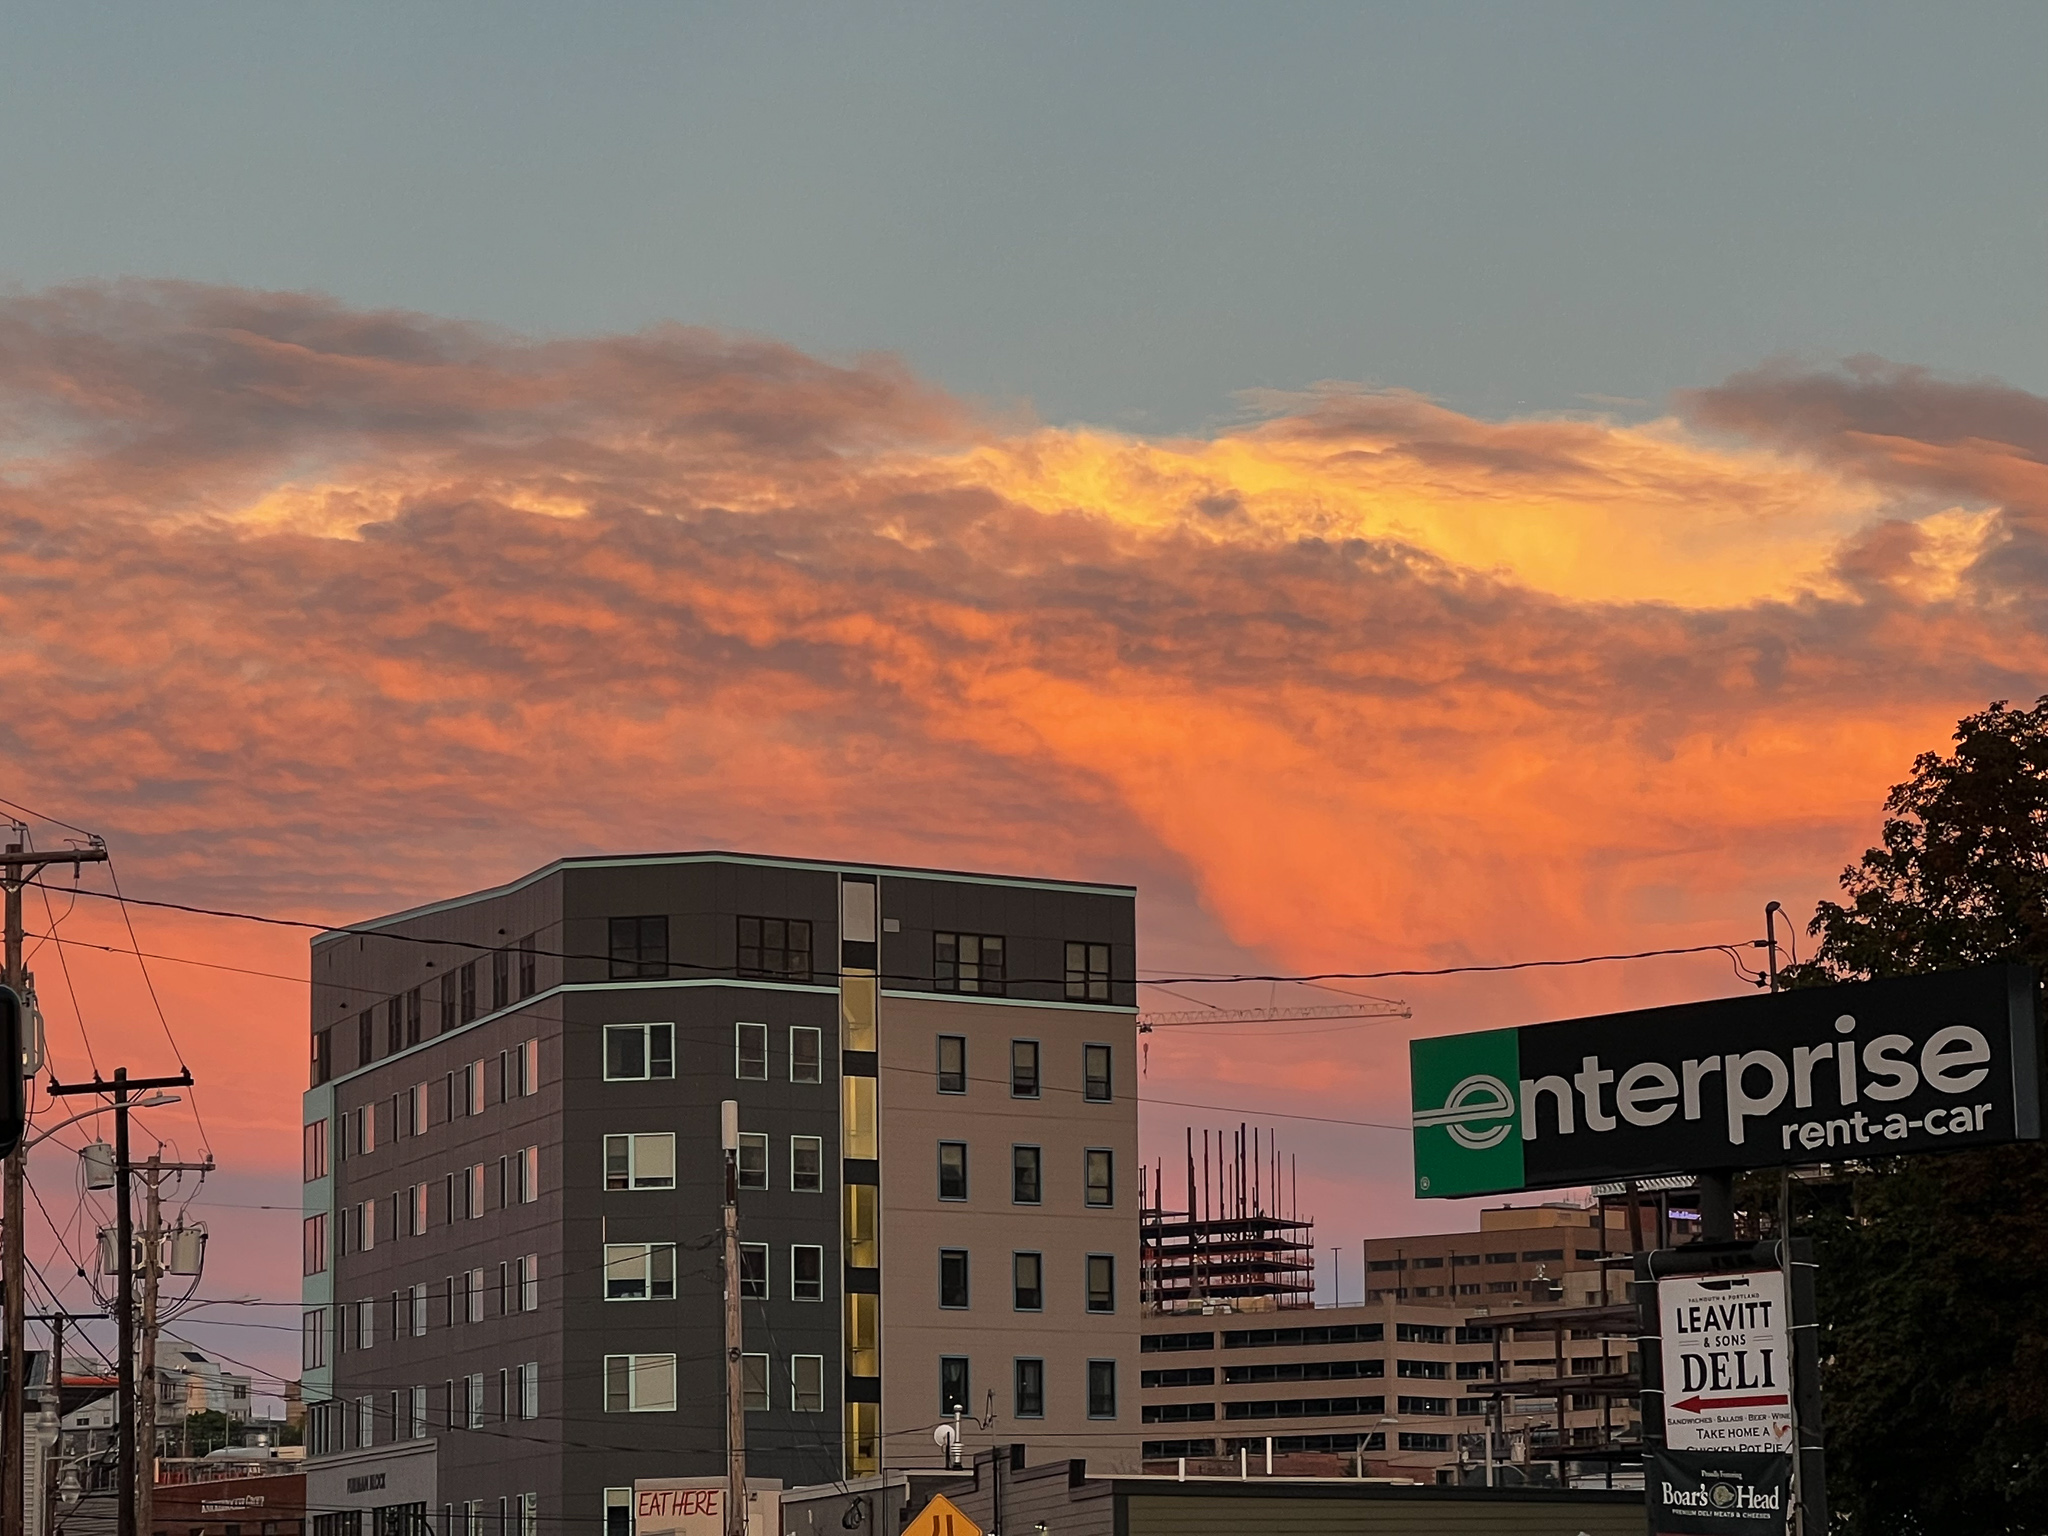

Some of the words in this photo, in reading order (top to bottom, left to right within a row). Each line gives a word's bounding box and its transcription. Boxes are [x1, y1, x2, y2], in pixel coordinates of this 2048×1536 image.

[1414, 1014, 1991, 1150] enterprise
[1782, 1103, 1992, 1150] rent-a-car
[1677, 1301, 1772, 1334] LEAVITT
[1703, 1337, 1710, 1348] &
[1715, 1334, 1746, 1348] SONS
[1680, 1349, 1775, 1392] DELI
[1696, 1428, 1725, 1440] TAKE
[1727, 1427, 1760, 1438] HOME
[1763, 1427, 1770, 1437] A
[639, 1492, 673, 1516] EAT
[672, 1490, 719, 1516] HERE
[1661, 1481, 1708, 1507] Boar's
[1736, 1485, 1780, 1510] Head
